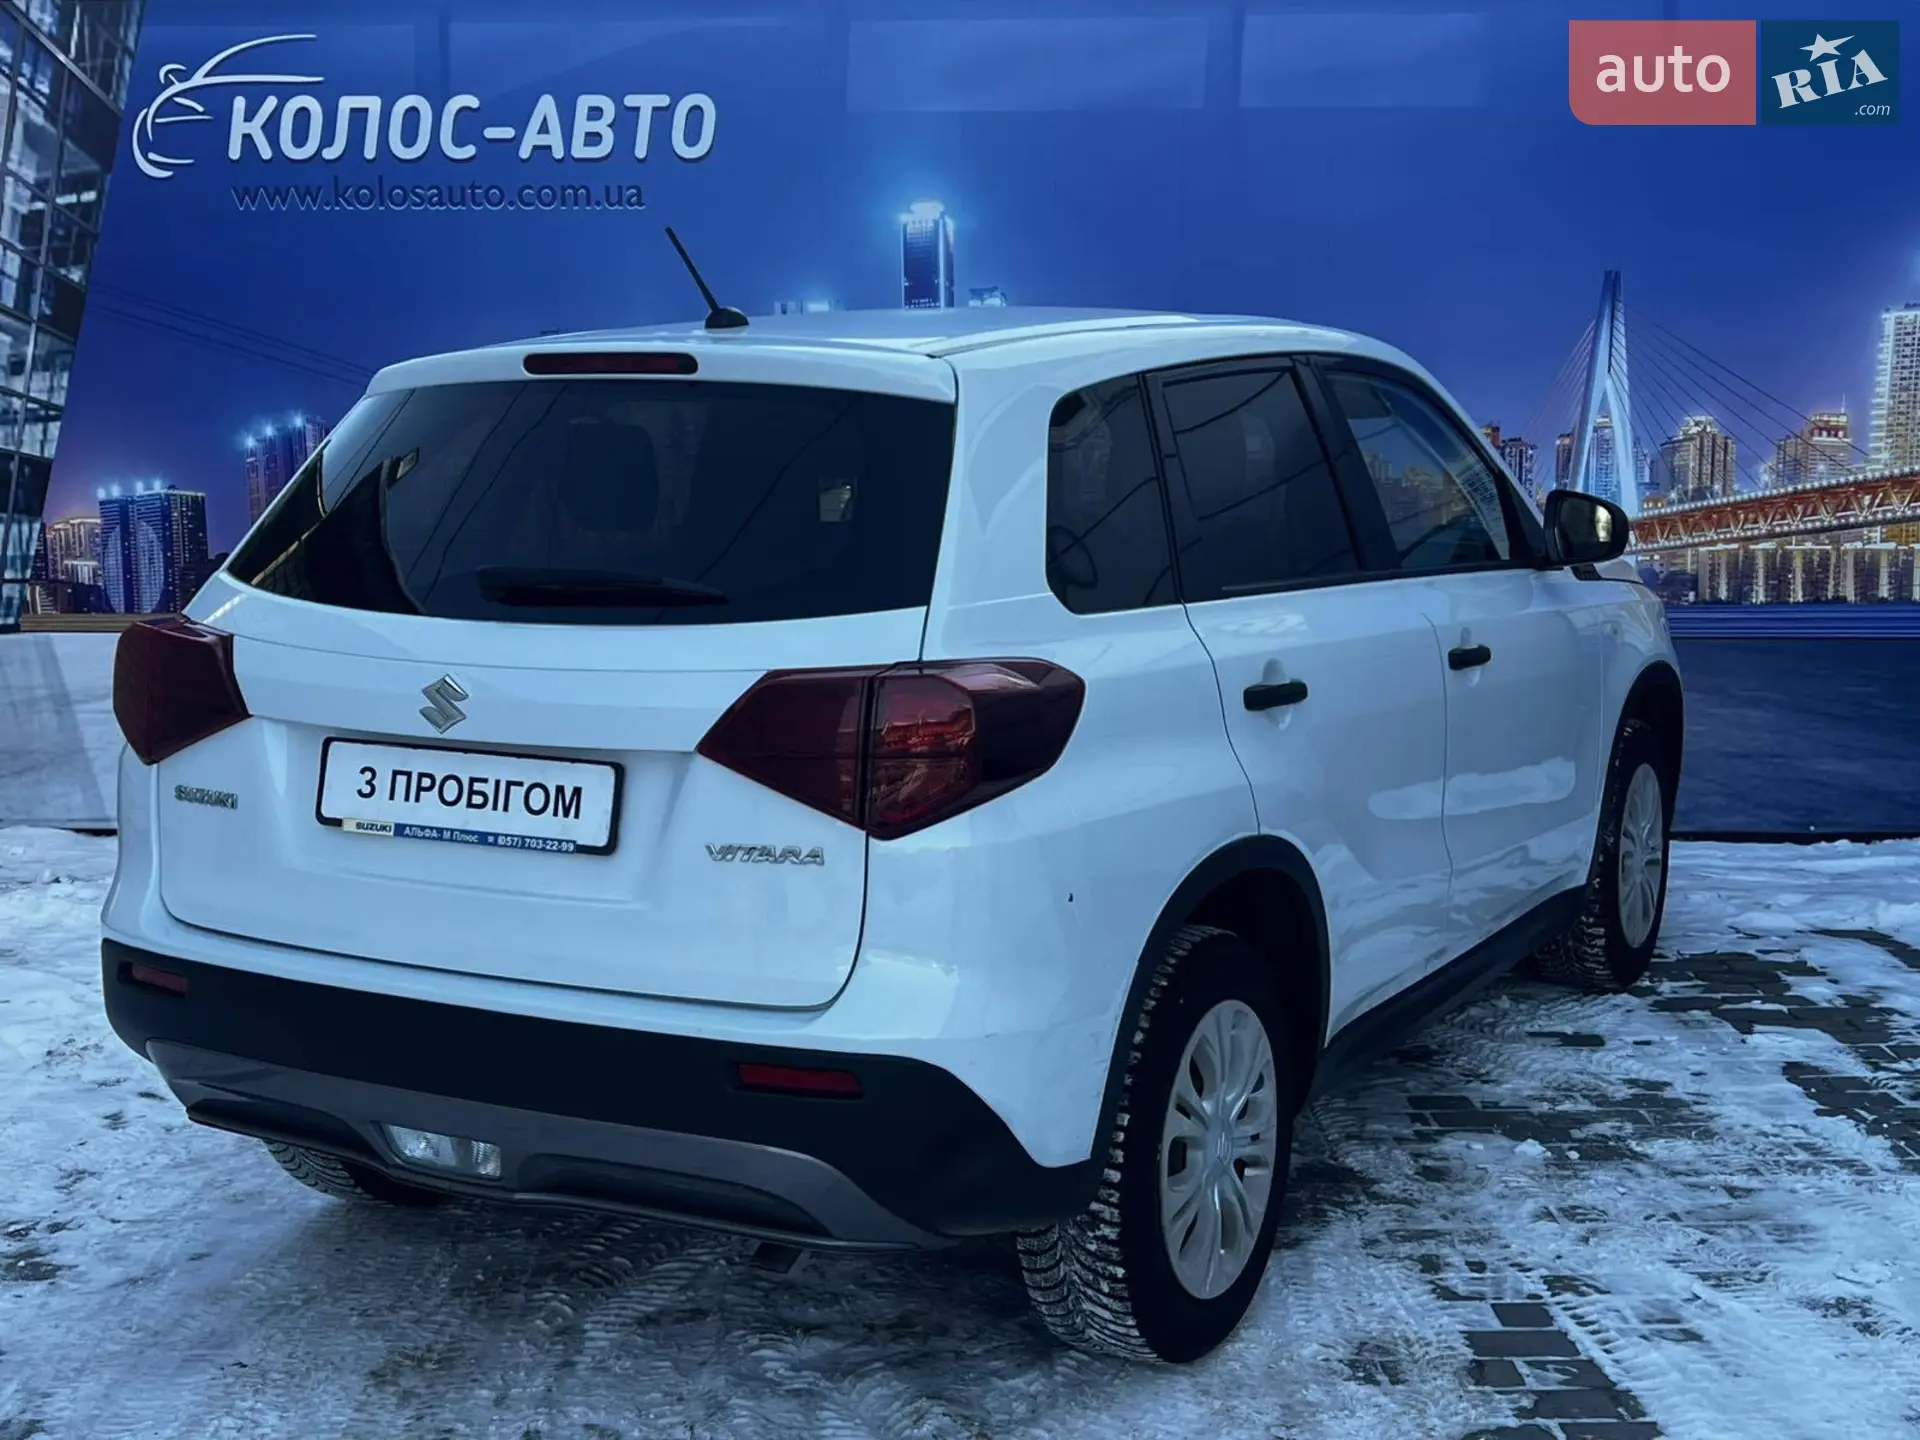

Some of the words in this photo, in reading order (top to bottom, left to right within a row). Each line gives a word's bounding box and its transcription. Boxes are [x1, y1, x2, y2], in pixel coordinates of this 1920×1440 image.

[228, 93, 717, 161] КОЛОС-АВТО
[231, 175, 646, 212] www.kolosauto.com.ua
[388, 769, 583, 820] ПРОБІГОМ
[355, 821, 392, 833] SUZUKI
[524, 838, 575, 852] 703-22-99
[705, 842, 826, 866] VITARA
